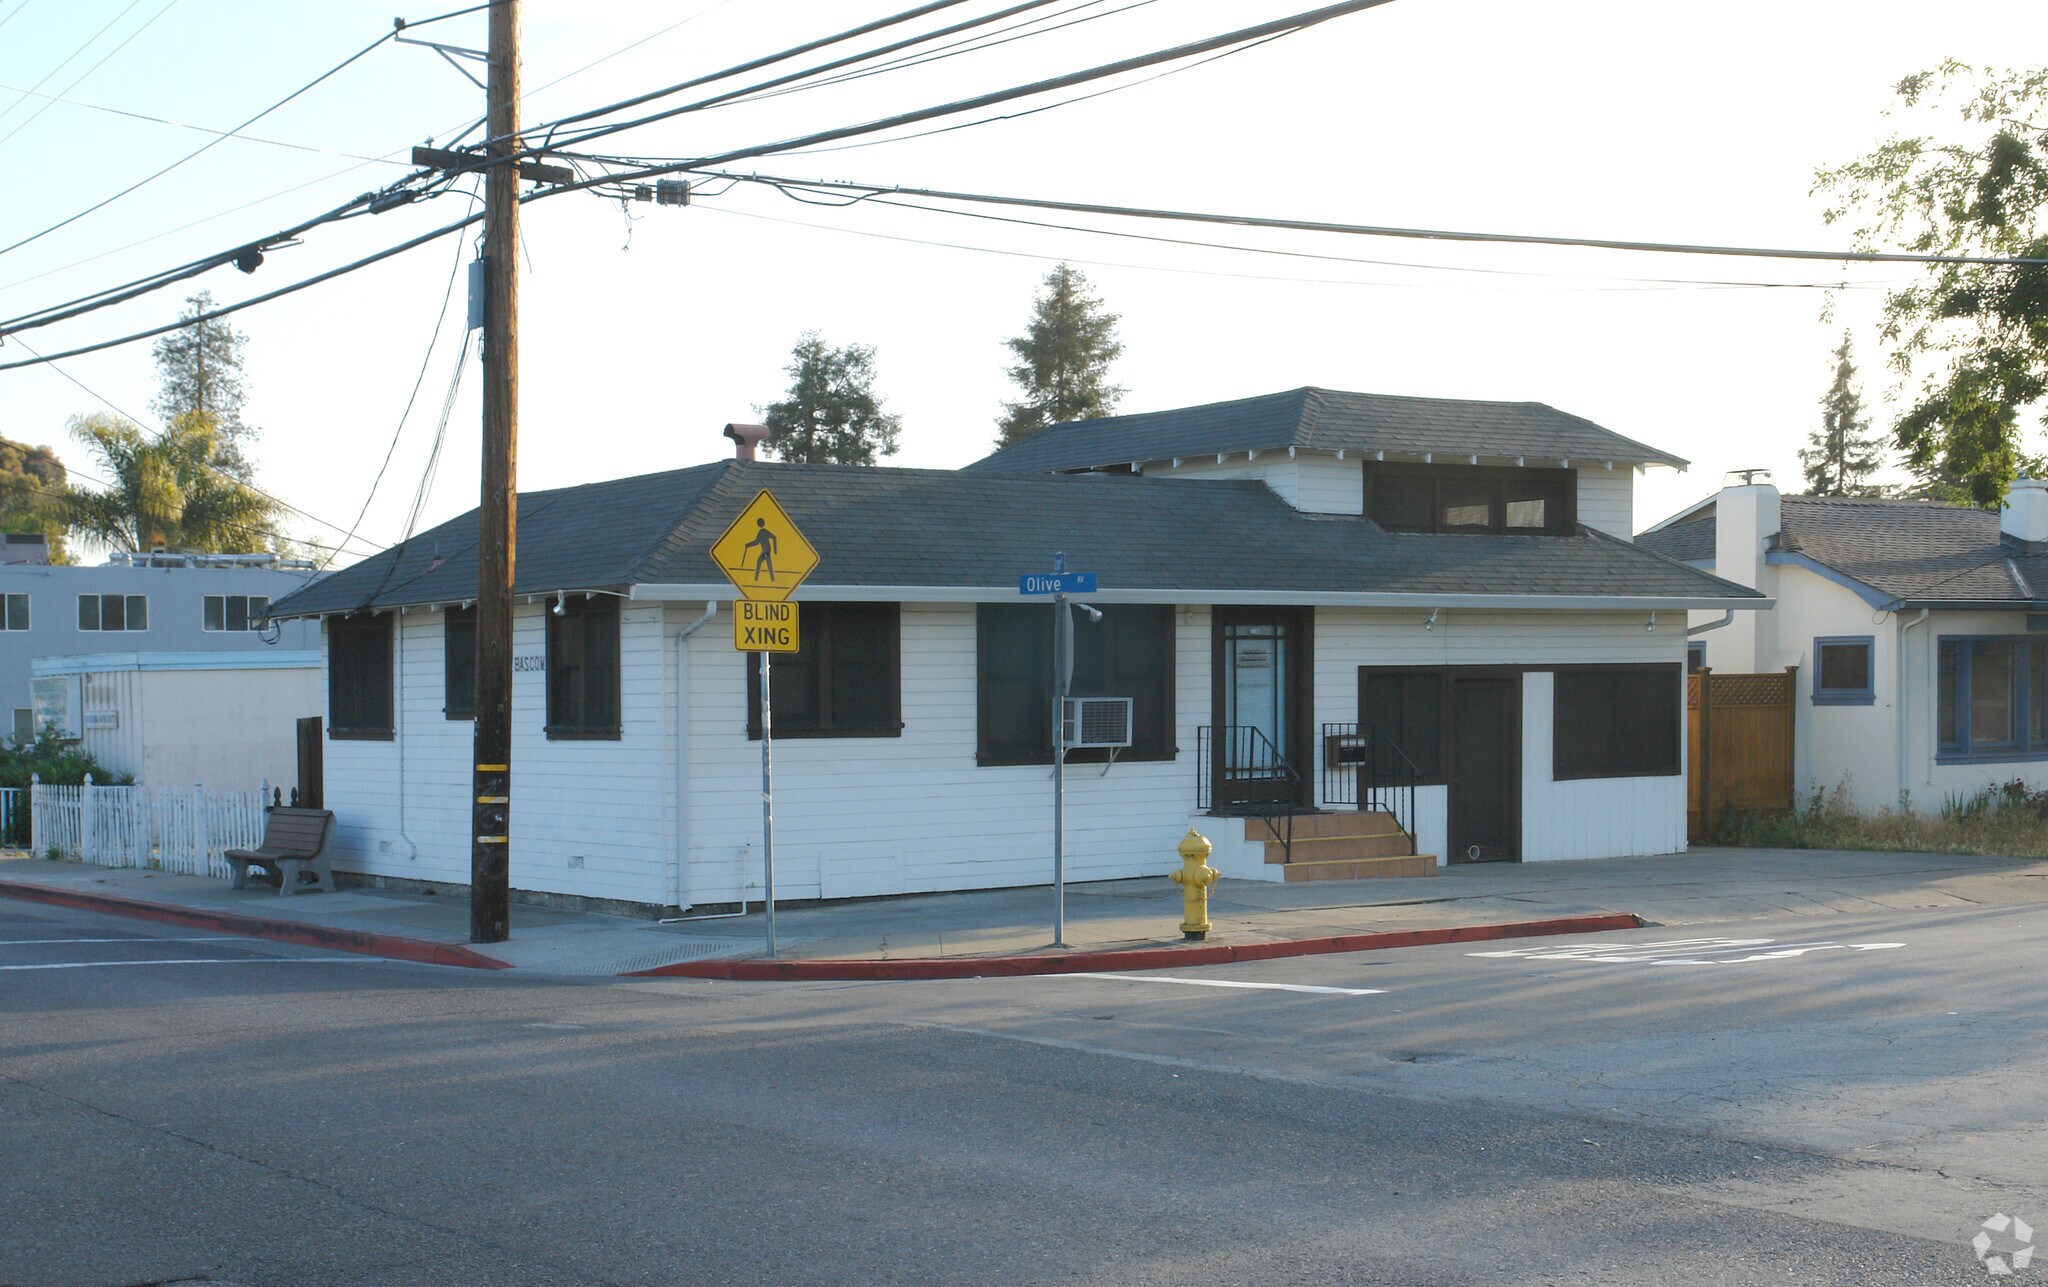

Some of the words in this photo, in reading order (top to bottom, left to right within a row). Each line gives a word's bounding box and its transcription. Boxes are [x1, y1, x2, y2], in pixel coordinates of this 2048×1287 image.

[1026, 577, 1061, 592] Olive
[744, 602, 790, 621] BLIND
[744, 626, 790, 645] XING
